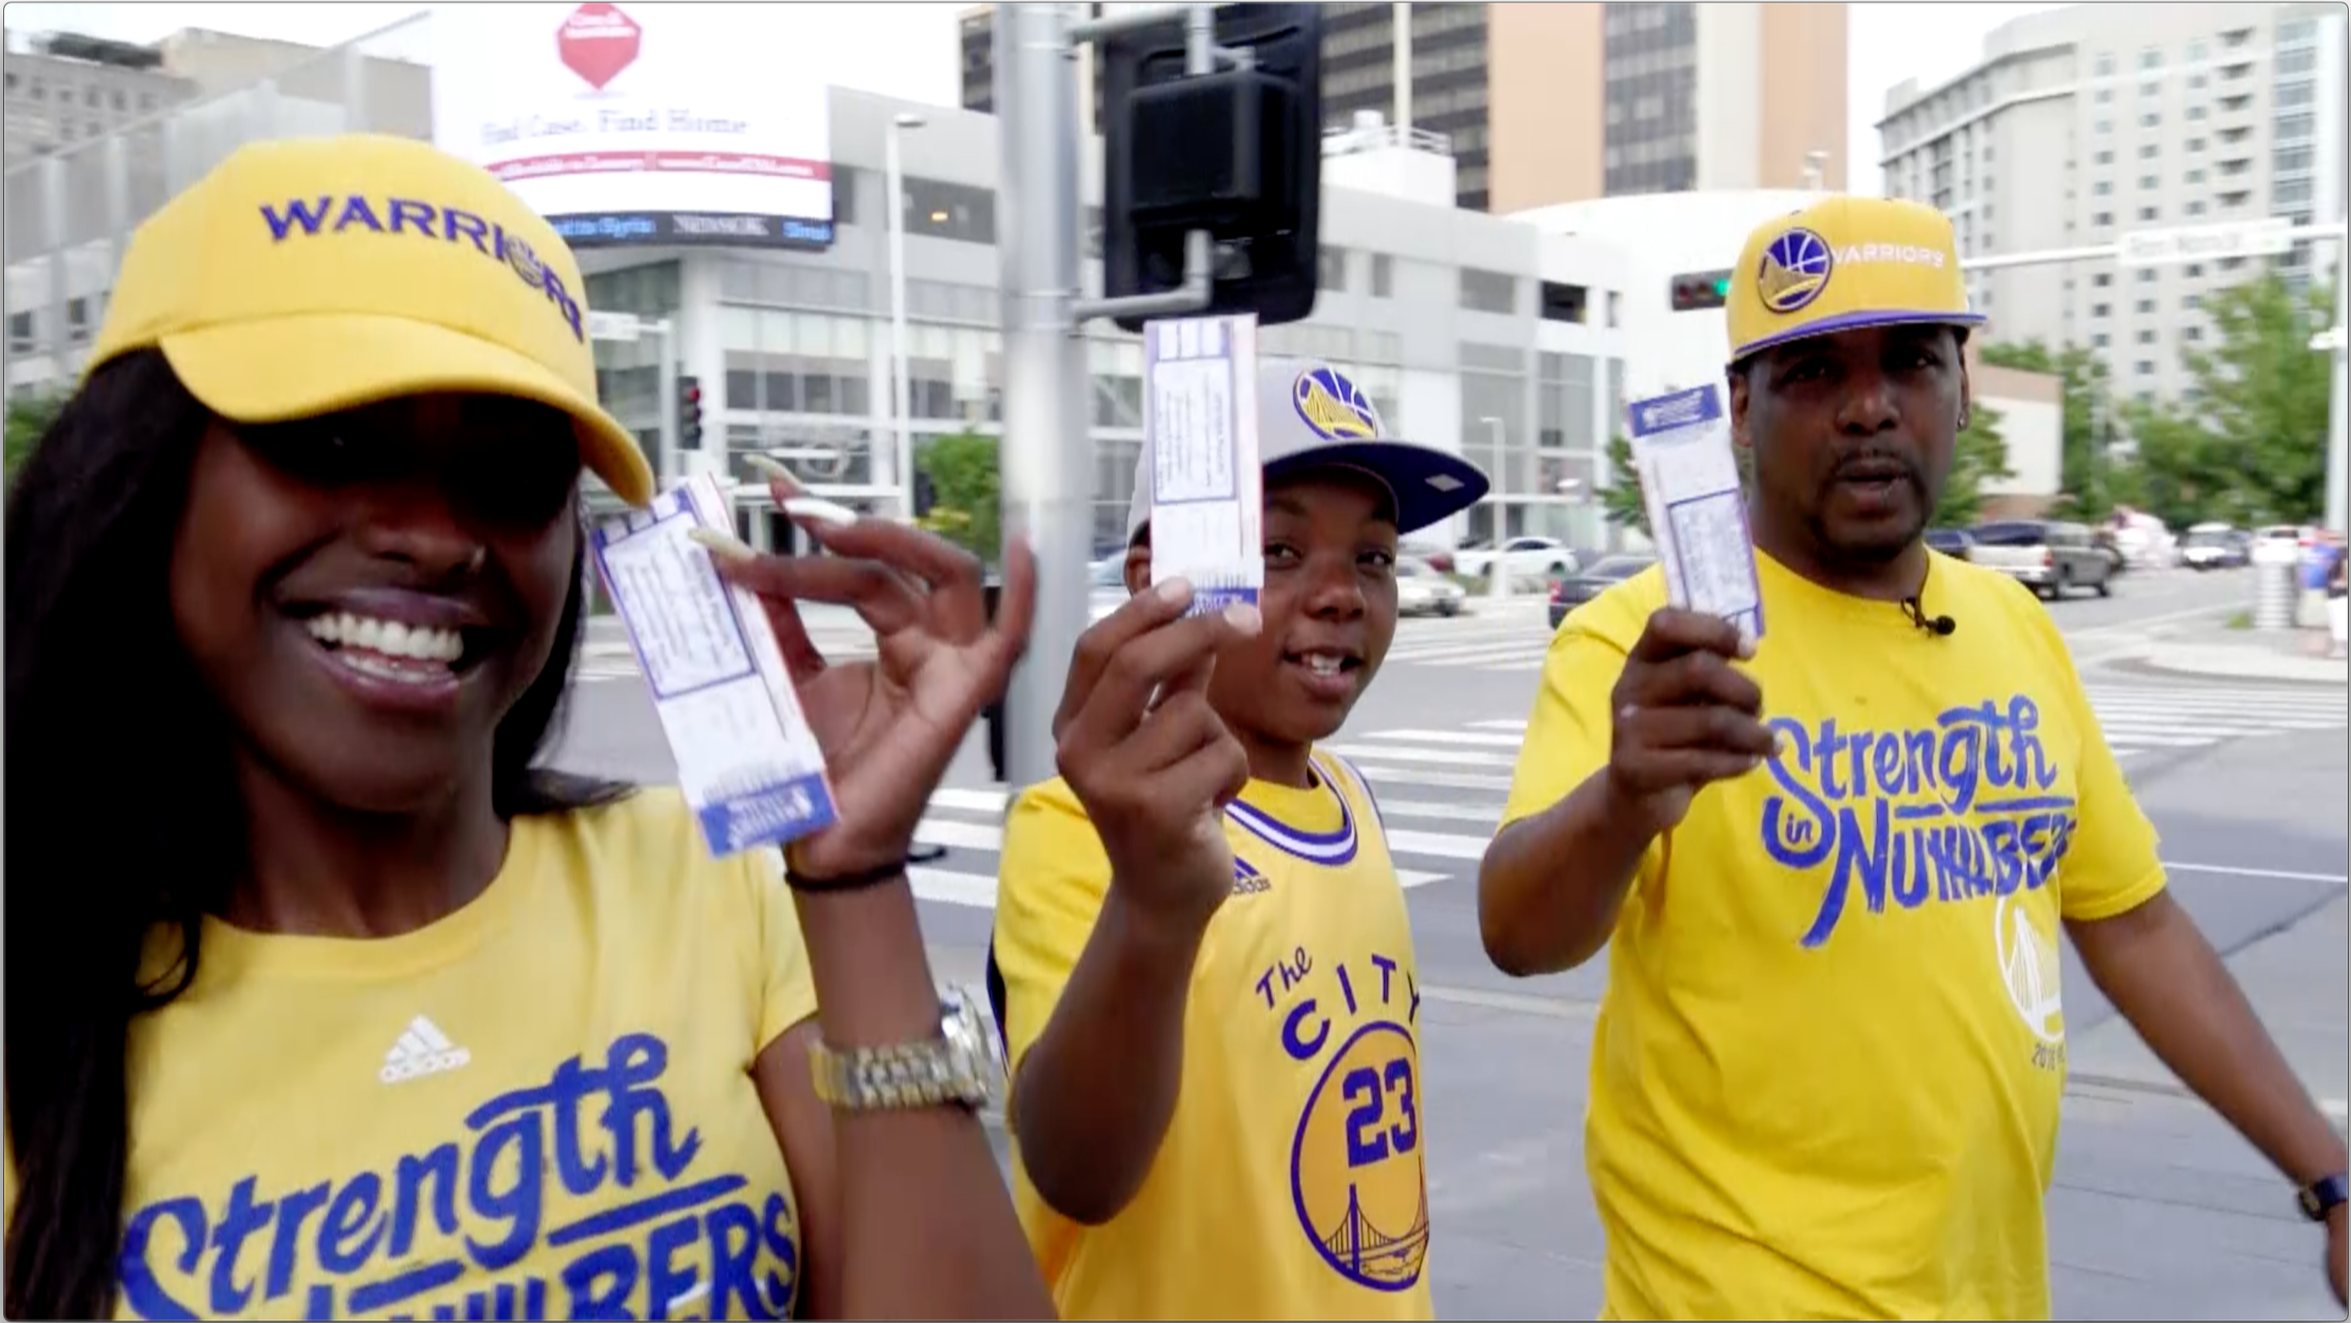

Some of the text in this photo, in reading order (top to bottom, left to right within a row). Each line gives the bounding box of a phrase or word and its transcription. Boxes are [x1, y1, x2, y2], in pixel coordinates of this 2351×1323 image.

[1761, 694, 2057, 868] Strength
[1785, 812, 1813, 844] in
[1255, 946, 1312, 1010] The
[1281, 953, 1420, 1061] CITY
[1342, 1056, 1417, 1168] 23
[117, 1032, 704, 1321] Strength
